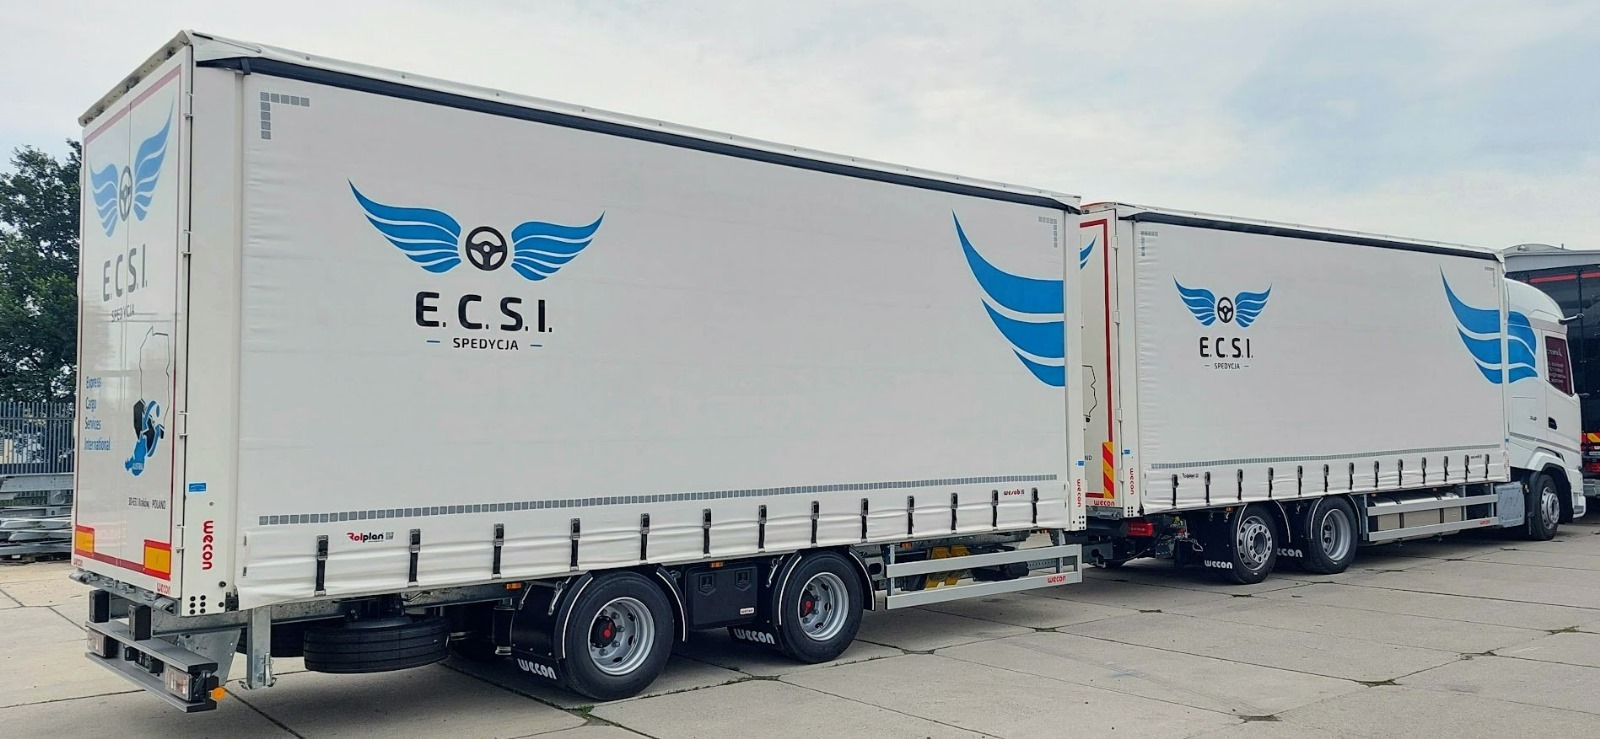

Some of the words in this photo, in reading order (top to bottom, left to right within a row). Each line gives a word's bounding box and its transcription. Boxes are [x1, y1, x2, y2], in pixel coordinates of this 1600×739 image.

[453, 337, 519, 350] SPEDYCJA
[1214, 362, 1241, 370] SPEDYCJA
[151, 499, 167, 510] POLAND
[346, 532, 384, 543] Rolplan
[202, 520, 214, 571] wecon
[1204, 560, 1233, 570] wecon
[1047, 575, 1067, 584] wecon
[157, 582, 171, 595] wecon
[734, 628, 775, 645] wecon
[517, 658, 557, 680] wecon
